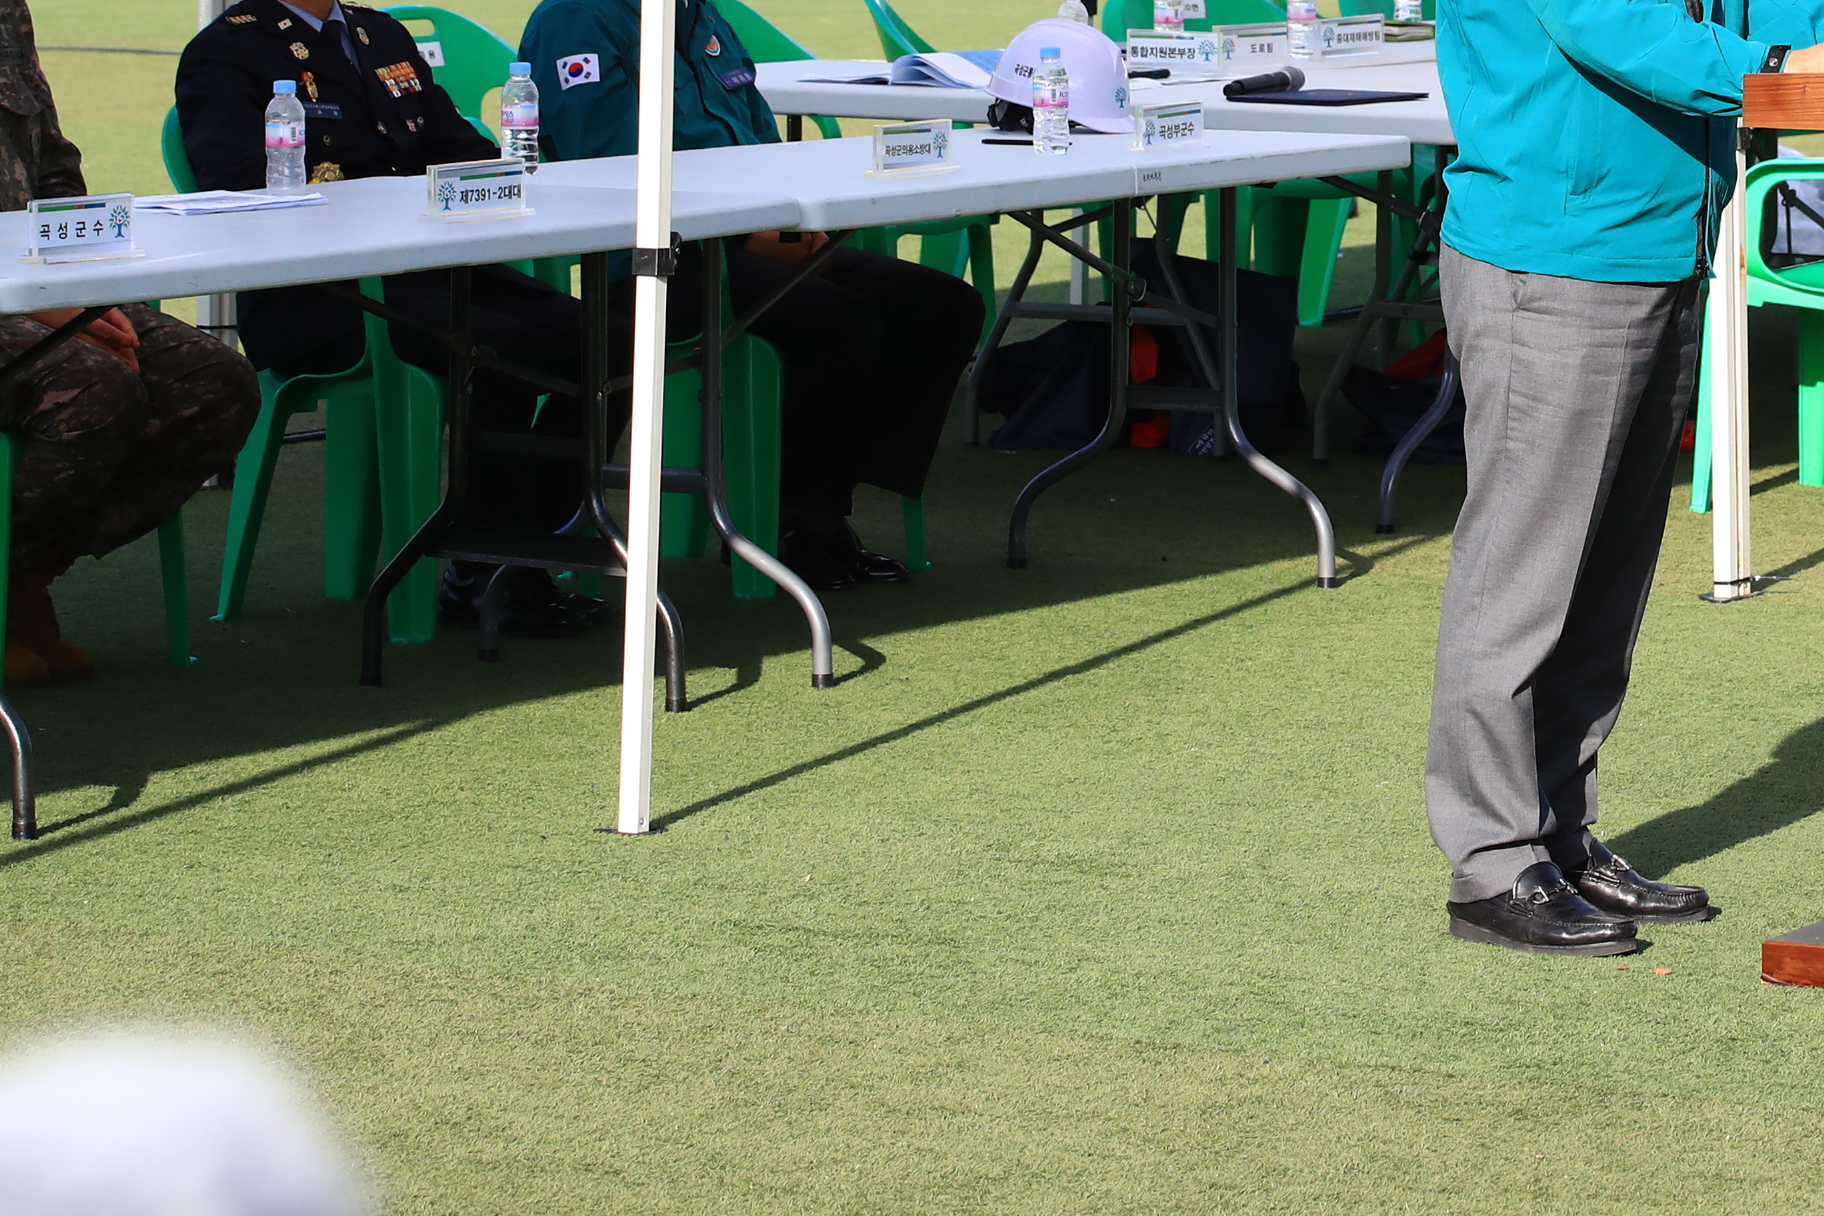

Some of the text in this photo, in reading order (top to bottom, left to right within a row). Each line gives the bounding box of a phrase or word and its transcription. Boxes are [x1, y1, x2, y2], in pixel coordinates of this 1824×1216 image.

[1130, 45, 1196, 60] 통합지원본부장
[1159, 122, 1195, 140] 곡성부군수
[885, 143, 932, 157] 곡성군의용소방대
[459, 183, 522, 204] 제7391-2대대
[39, 219, 105, 241] 곡성군수
